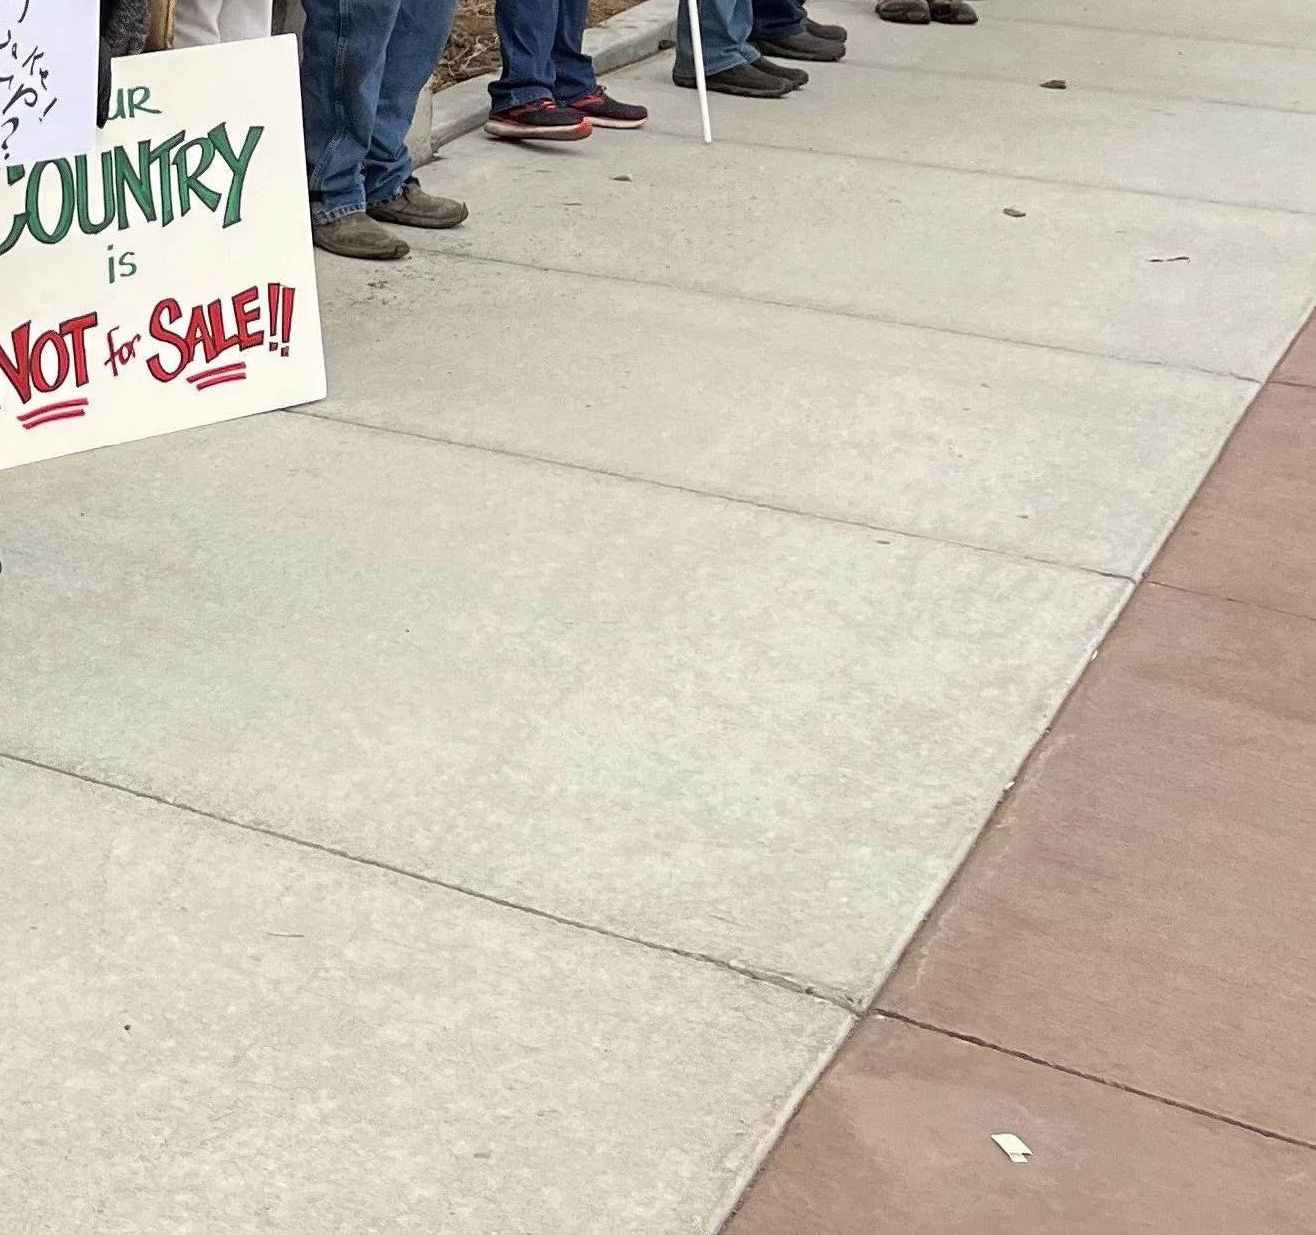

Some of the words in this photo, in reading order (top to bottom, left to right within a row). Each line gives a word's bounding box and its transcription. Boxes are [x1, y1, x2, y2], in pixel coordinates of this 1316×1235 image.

[108, 245, 138, 284] is
[104, 325, 141, 376] for
[146, 282, 296, 383] SALE!!
